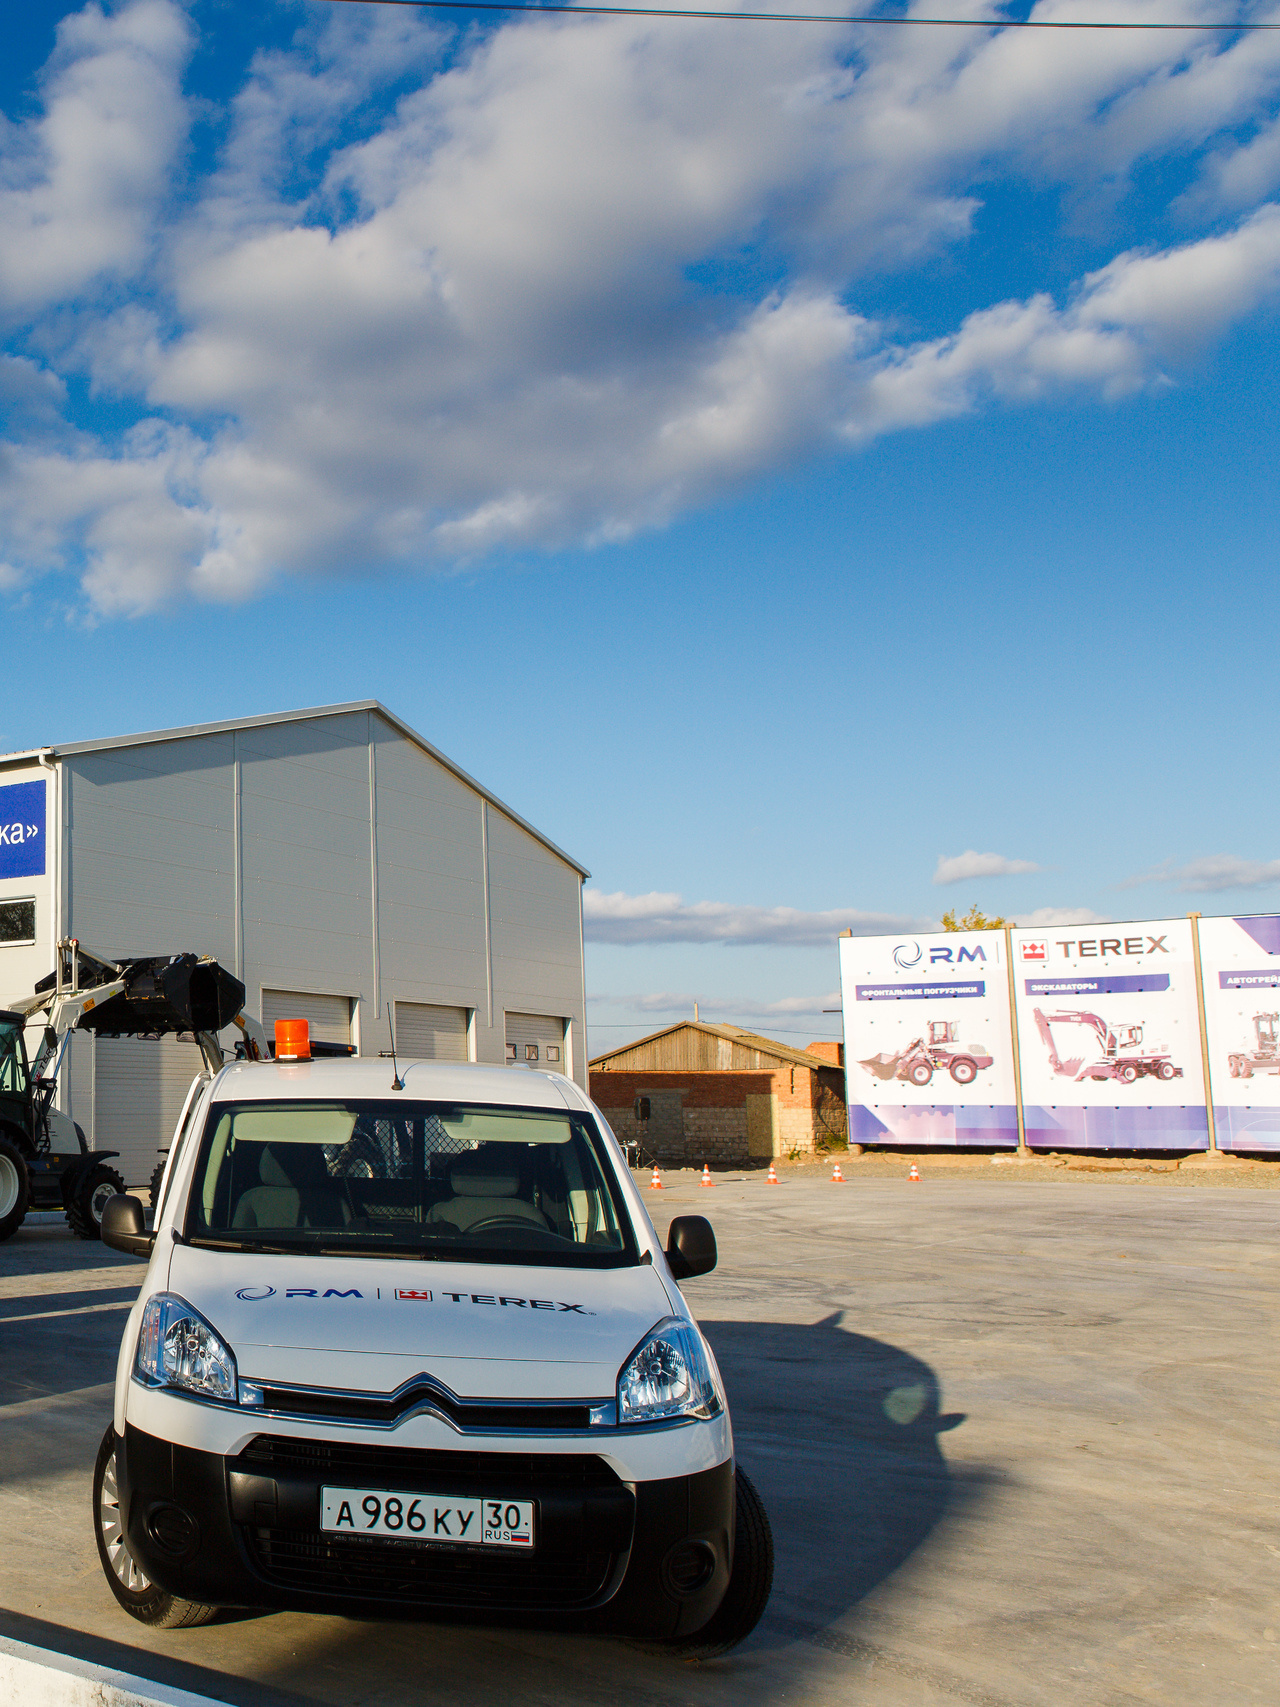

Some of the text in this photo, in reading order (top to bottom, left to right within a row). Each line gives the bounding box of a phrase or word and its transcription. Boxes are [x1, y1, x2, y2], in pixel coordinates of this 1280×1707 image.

[929, 945, 988, 964] RM
[861, 986, 978, 997] ФРОНТАЛЬНЫЕ ПОГРУЗЧИКИ
[1031, 983, 1098, 991] ЭКСКАВАТОРЫ
[285, 1288, 364, 1299] RM
[487, 1502, 521, 1530] 30
[485, 1530, 511, 1541] RUS
